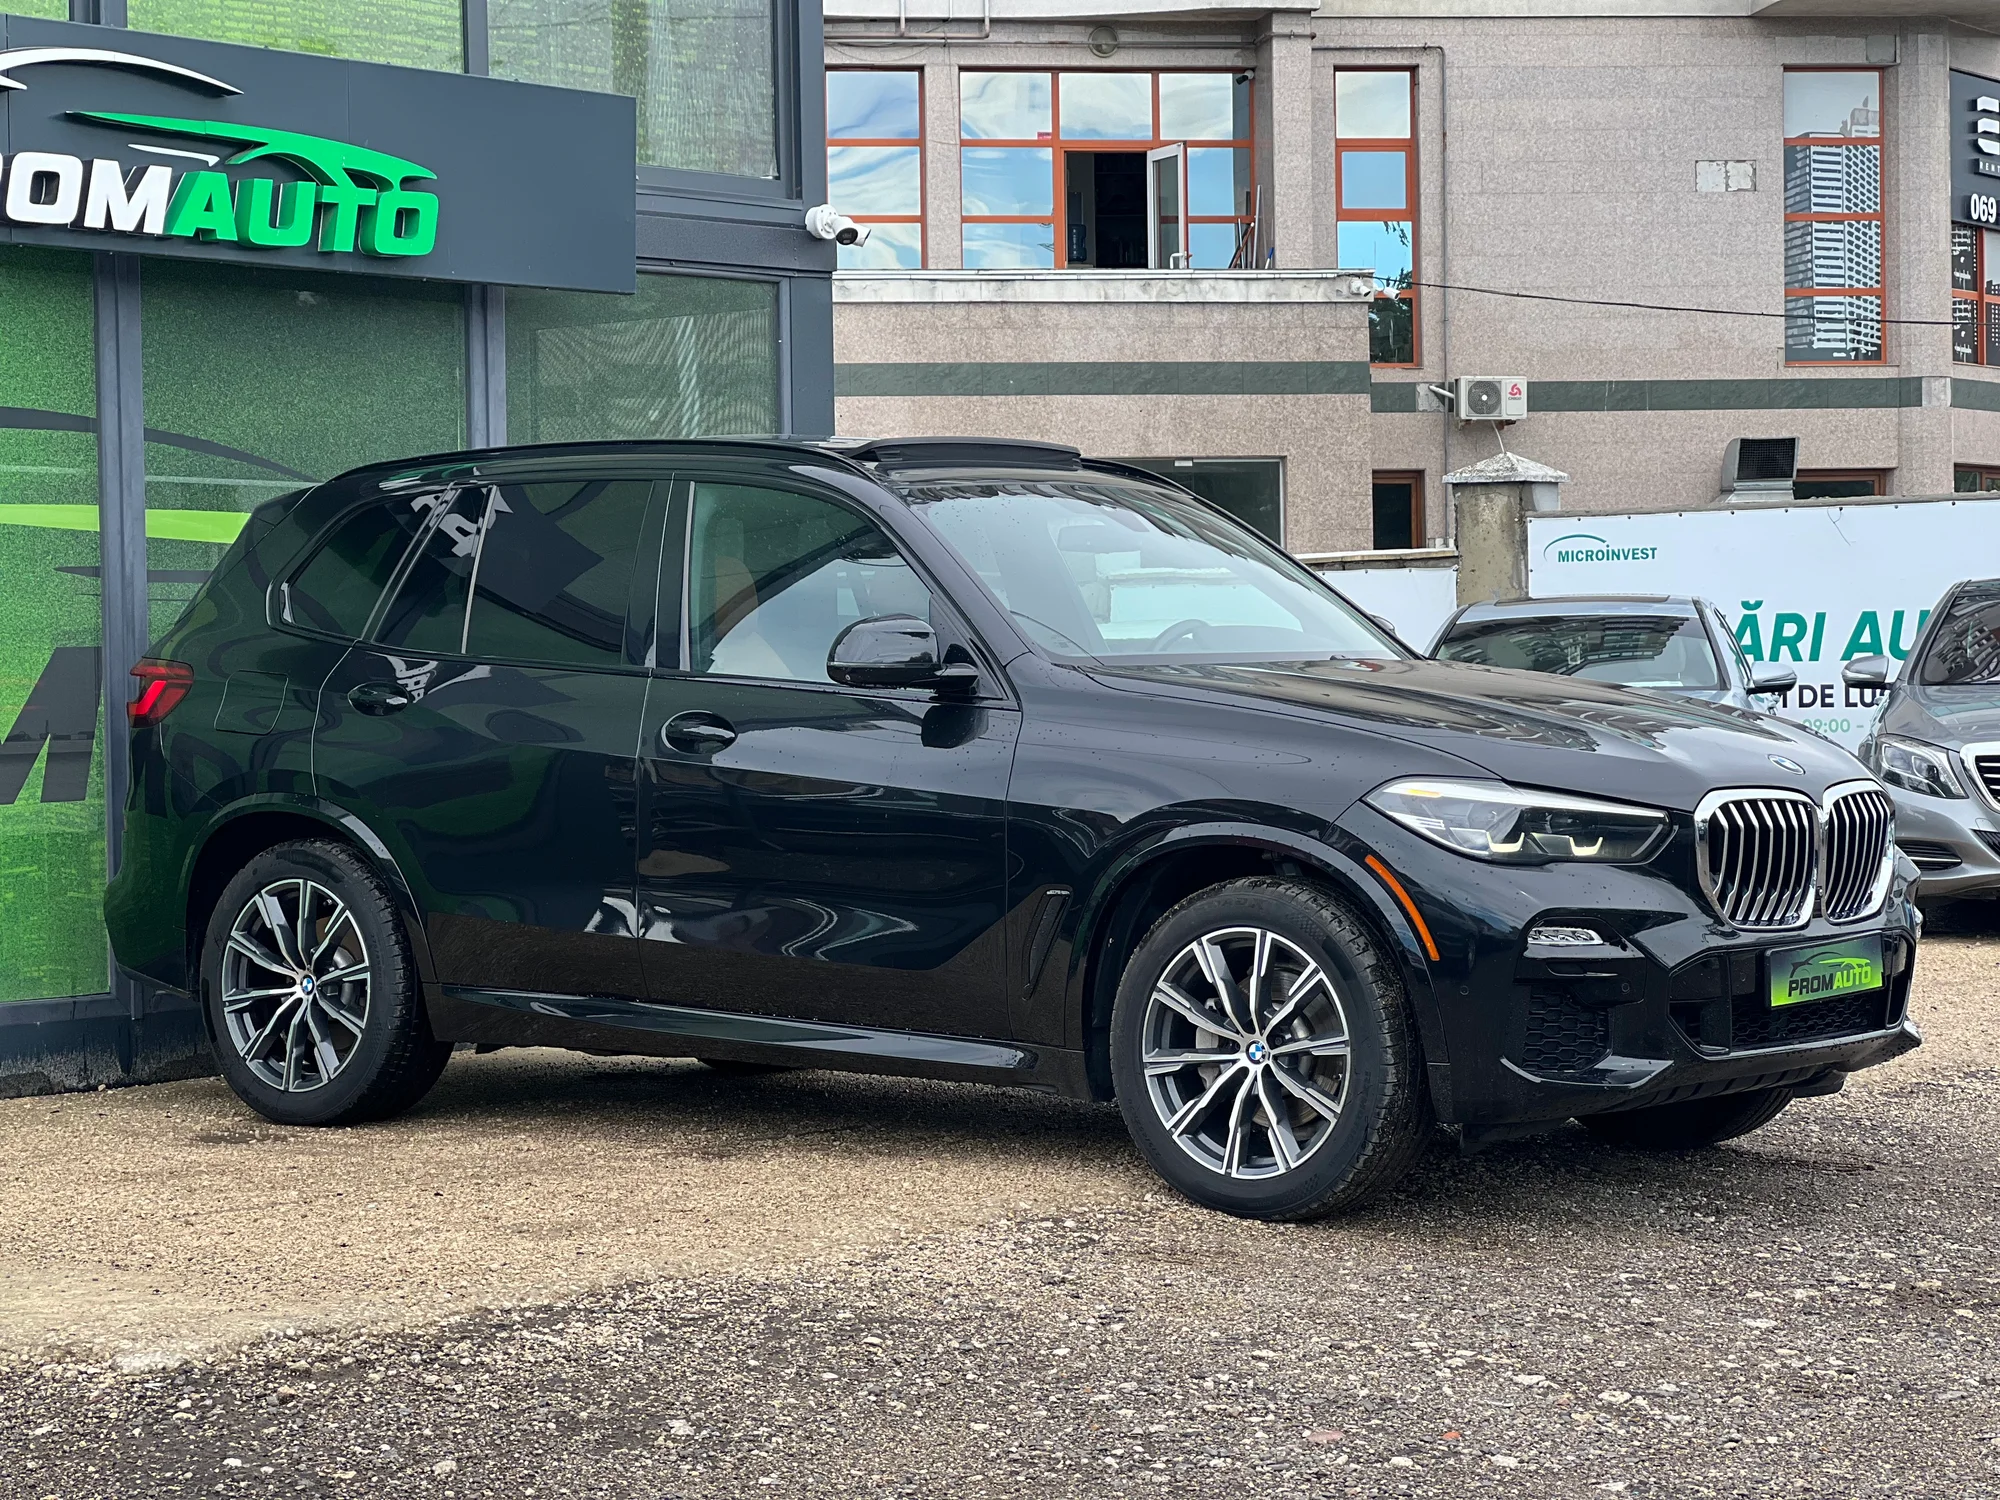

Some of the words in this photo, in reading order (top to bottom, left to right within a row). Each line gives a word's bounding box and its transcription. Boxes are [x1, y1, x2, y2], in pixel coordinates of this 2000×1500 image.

[1971, 193, 1996, 223] 069
[1723, 600, 1826, 662] ĂRI
[1798, 684, 1834, 708] DE
[1788, 965, 1871, 997] PROMAUTO
